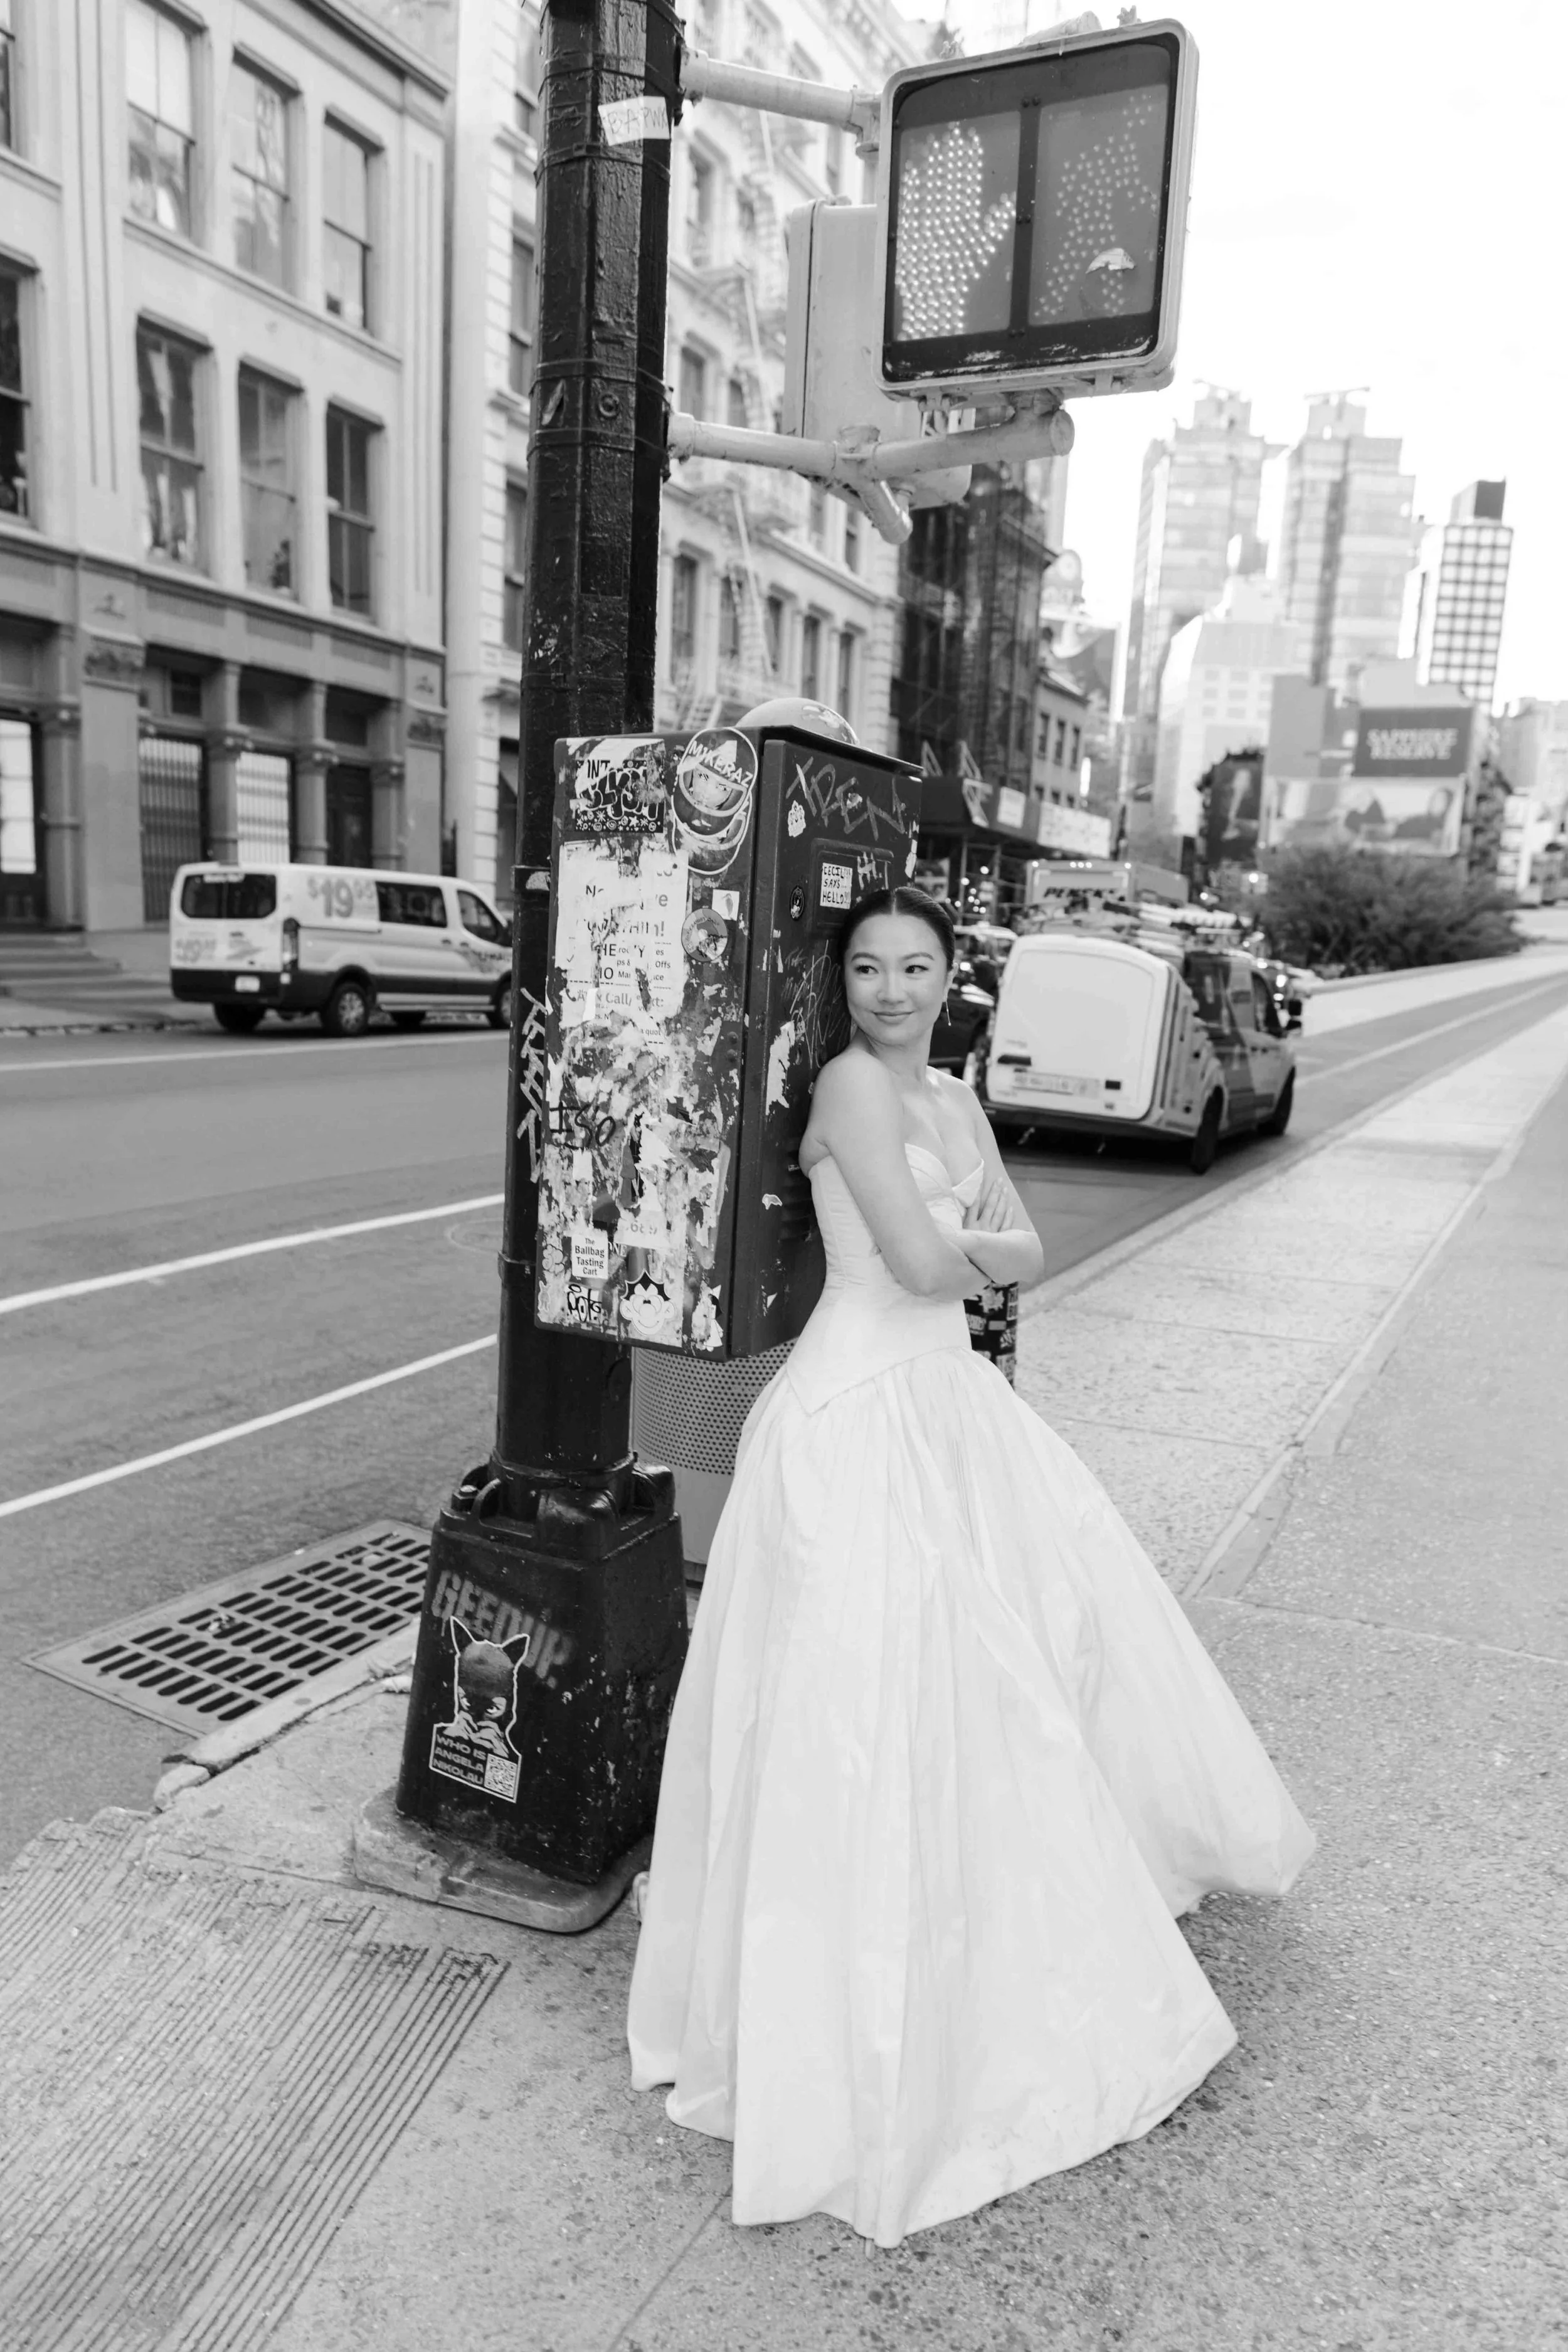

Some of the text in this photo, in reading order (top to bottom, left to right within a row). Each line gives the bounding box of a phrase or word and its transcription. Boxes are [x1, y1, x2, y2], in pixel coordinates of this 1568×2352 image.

[585, 1237, 595, 1246] The
[575, 1245, 605, 1258] Ballbag
[577, 1256, 604, 1269] Tasting
[583, 1267, 598, 1276] Cart
[437, 1734, 487, 1761] WHO IS
[435, 1746, 485, 1774] ANGELA
[433, 1757, 484, 1786] NIKOLAU
